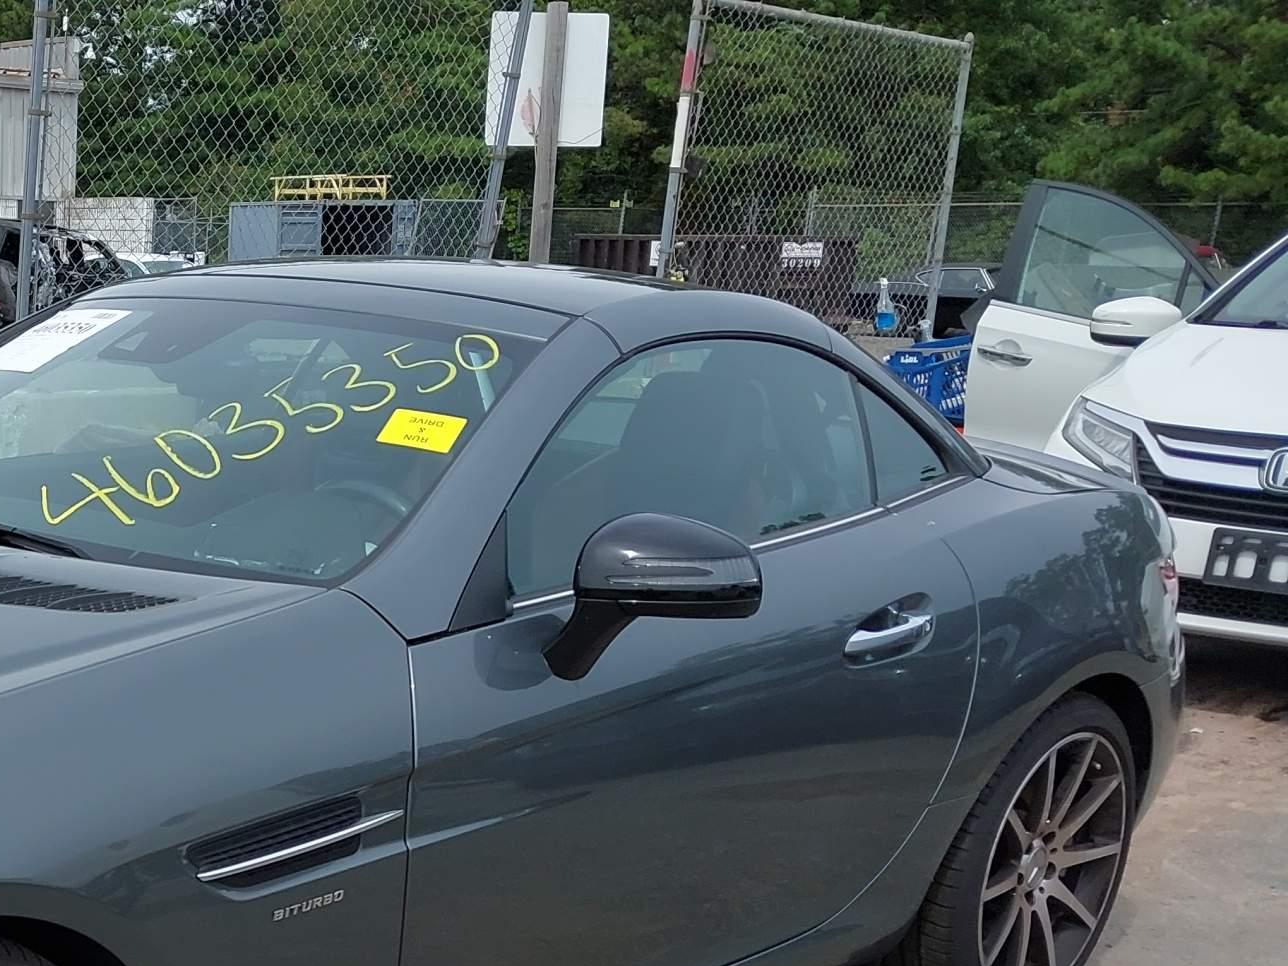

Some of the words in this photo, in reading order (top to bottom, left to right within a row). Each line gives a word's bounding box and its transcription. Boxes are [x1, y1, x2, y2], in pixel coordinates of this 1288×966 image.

[41, 334, 500, 525] 46035350
[409, 416, 445, 428] DRIVE
[403, 433, 429, 443] RUN
[272, 889, 345, 921] BITURBO
